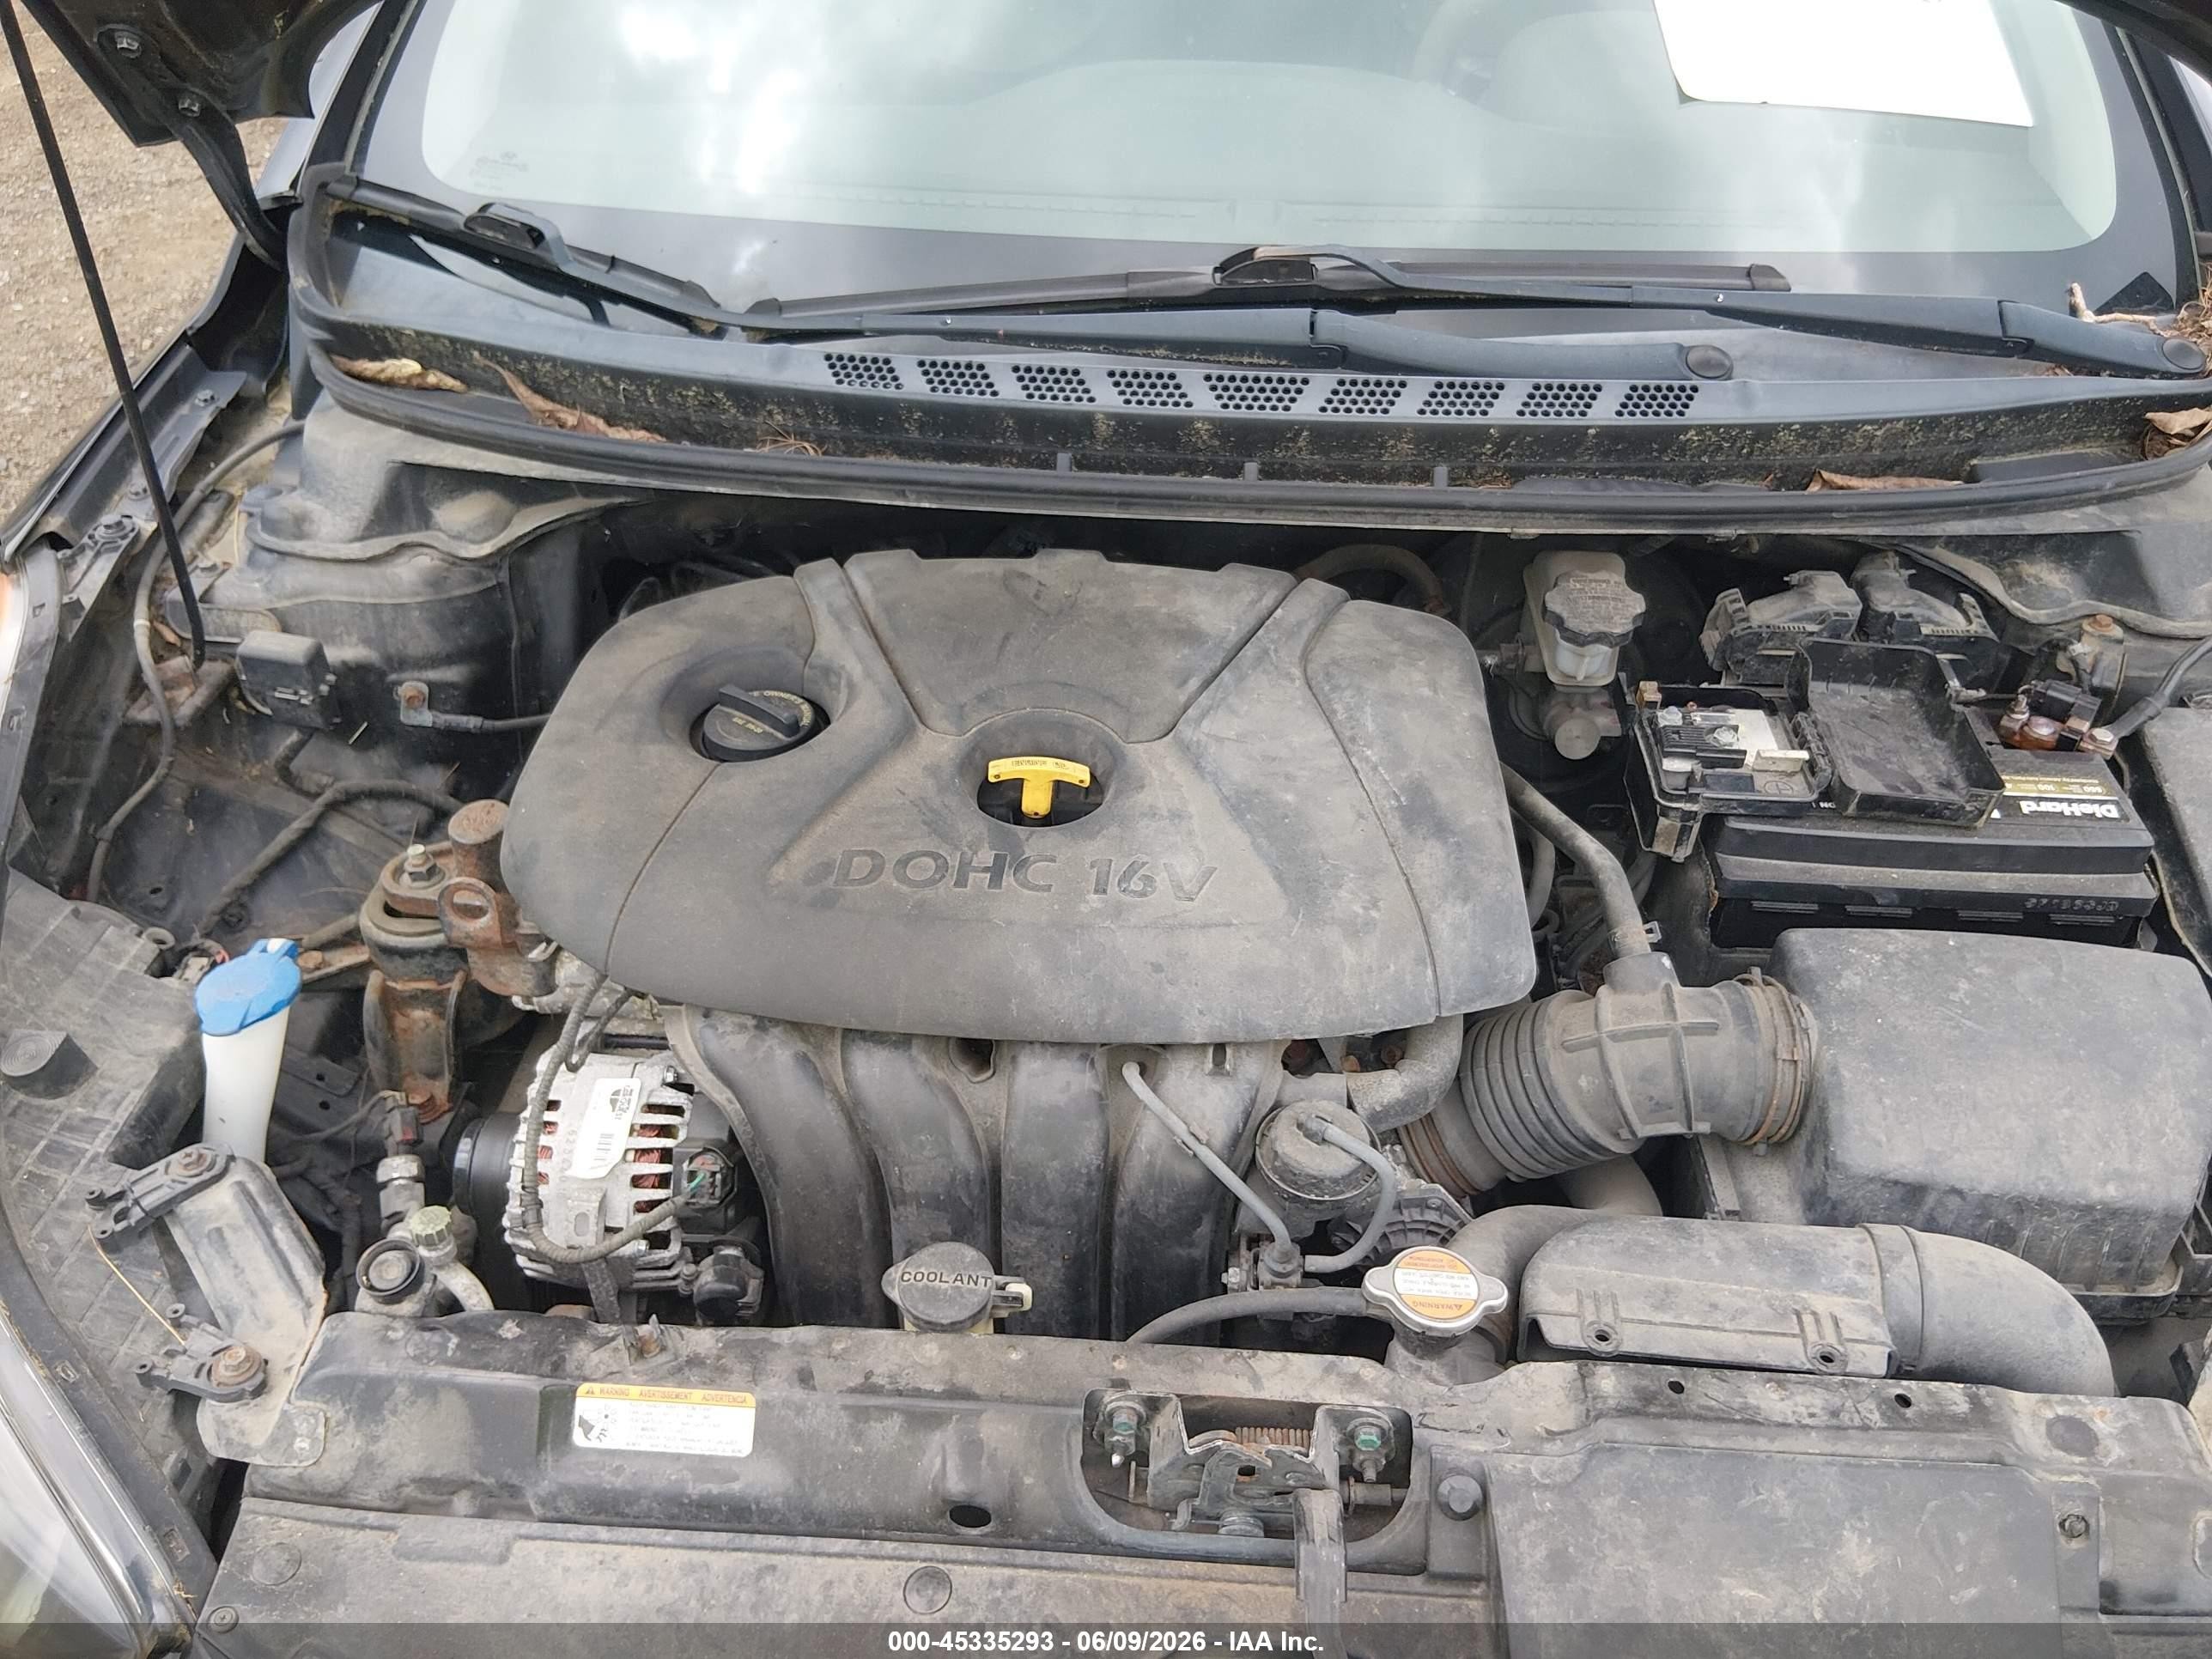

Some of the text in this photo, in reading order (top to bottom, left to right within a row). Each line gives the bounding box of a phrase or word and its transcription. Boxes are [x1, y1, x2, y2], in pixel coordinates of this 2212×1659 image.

[2019, 800, 2120, 818] DieHard
[831, 848, 1217, 902] DOHC 16V
[901, 1271, 992, 1288] COOLANT
[1413, 1300, 1457, 1311] WARNING
[599, 1387, 747, 1404] WARNING AVERTISSEMENT ADVERTENCIA
